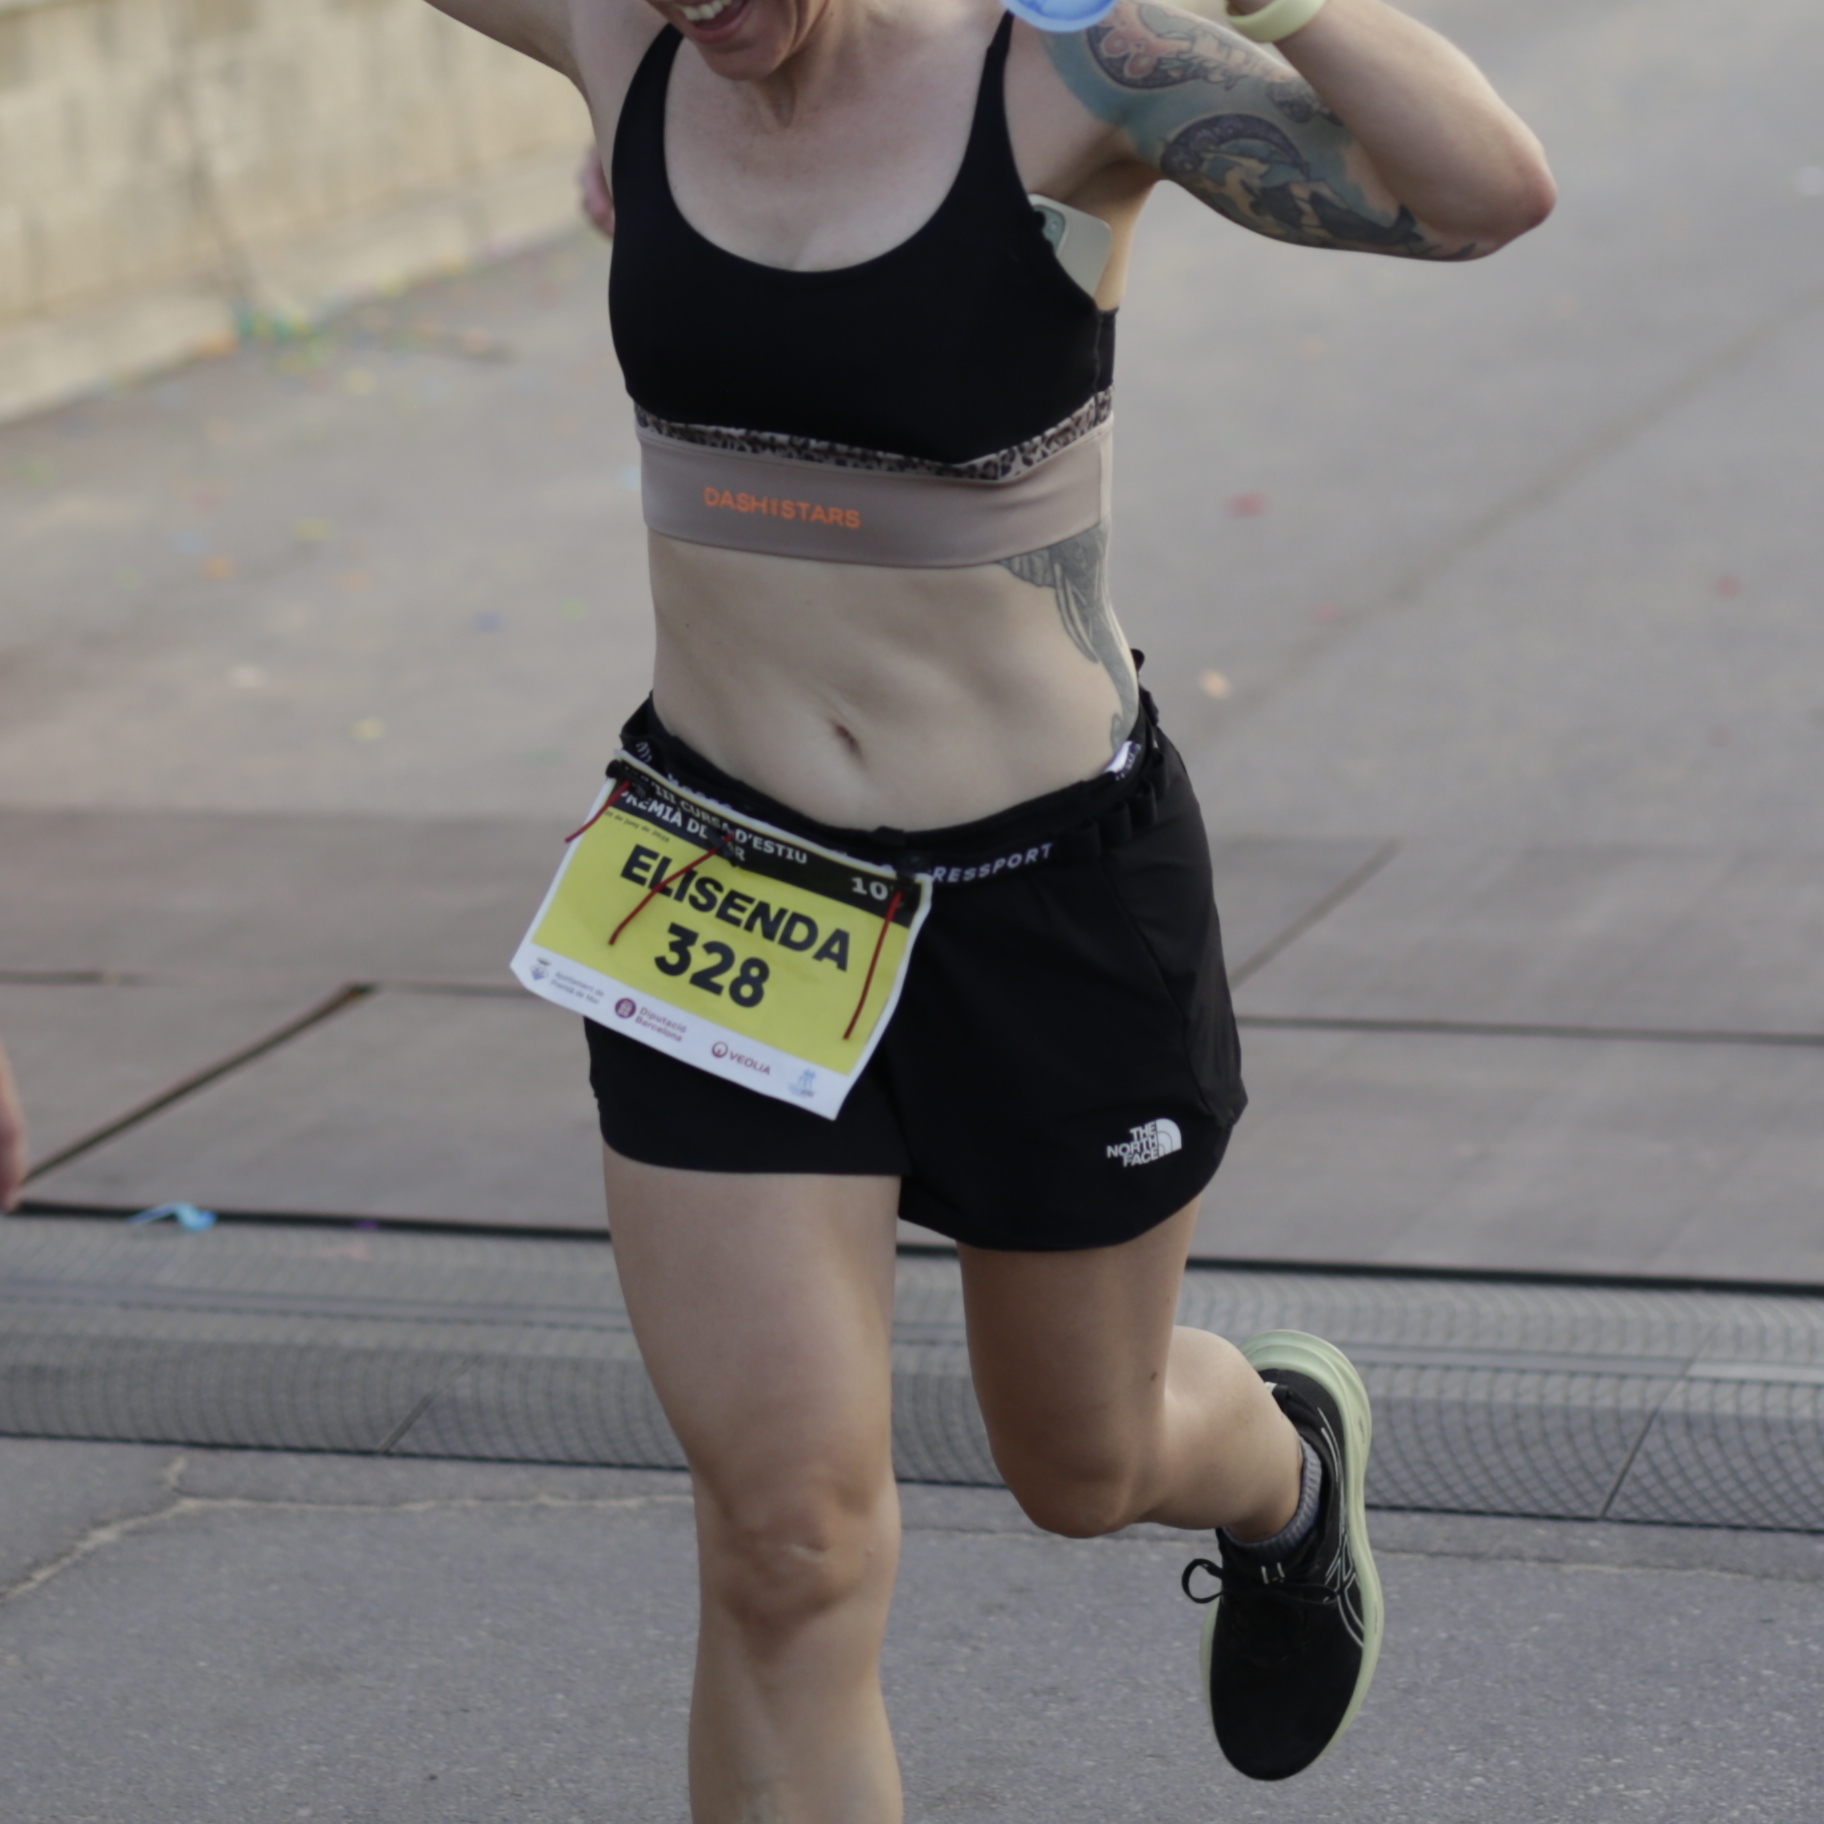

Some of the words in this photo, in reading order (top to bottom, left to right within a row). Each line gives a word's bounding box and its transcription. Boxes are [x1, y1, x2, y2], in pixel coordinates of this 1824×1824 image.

[734, 828, 808, 864] D'ESTIU
[930, 842, 1054, 883] RESSPORT
[619, 843, 851, 973] ELISENDA
[654, 921, 771, 1008] 328
[634, 1015, 684, 1043] Barcelona
[639, 1006, 689, 1034] Diputació
[728, 1049, 772, 1075] VEOLIA
[1129, 1120, 1157, 1143] THE
[1106, 1133, 1159, 1159] NORTH
[1122, 1147, 1160, 1168] FACE
